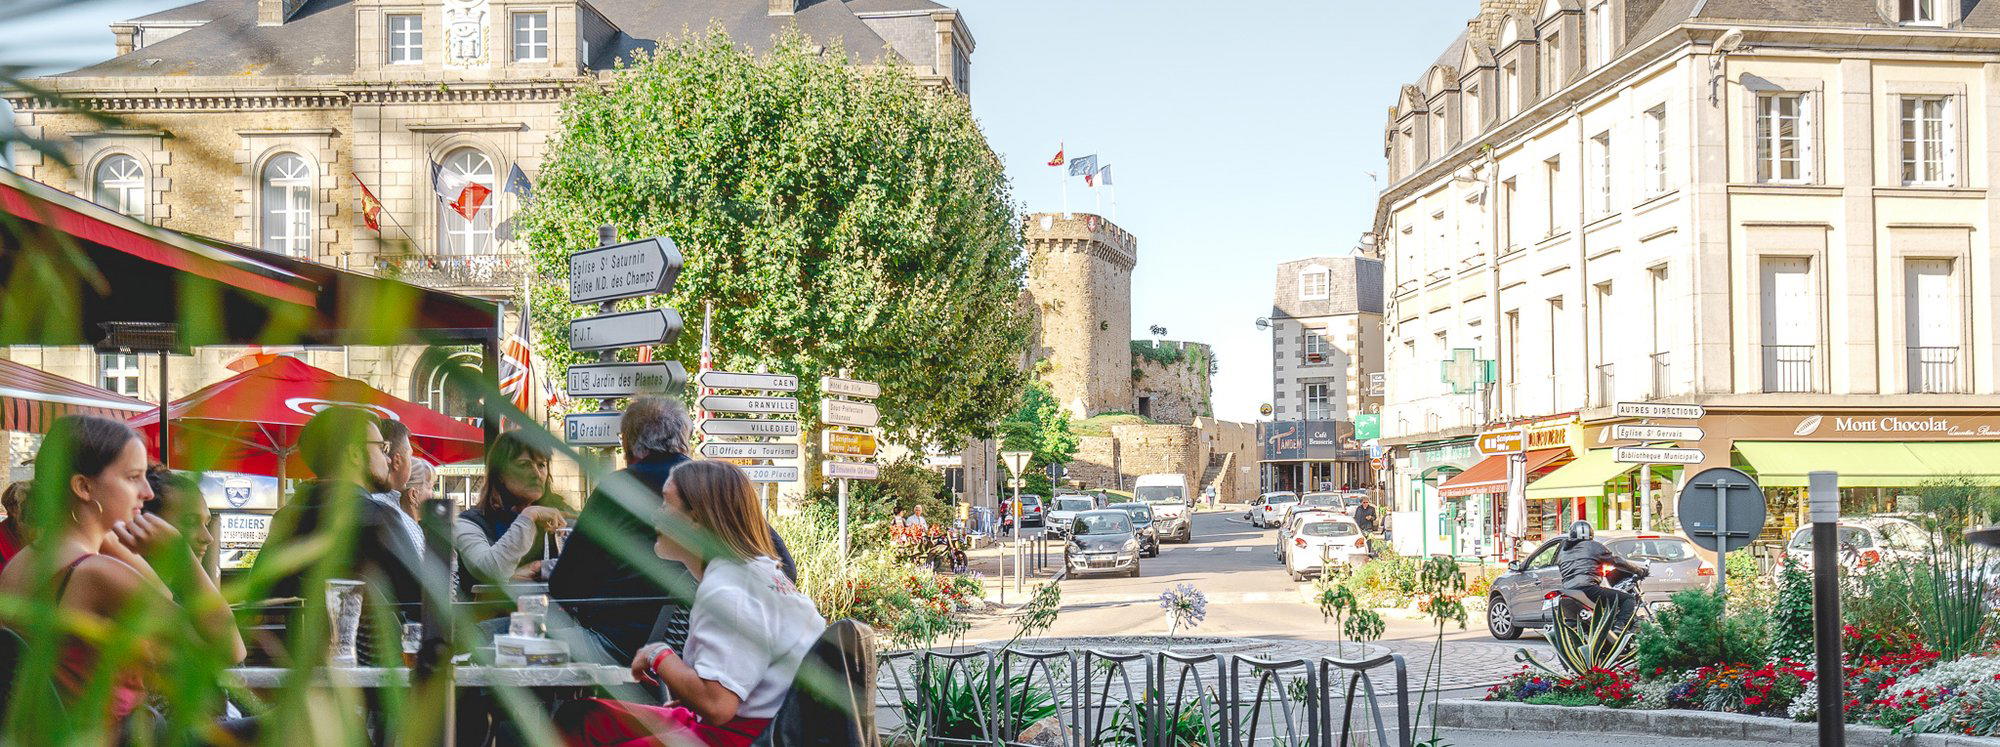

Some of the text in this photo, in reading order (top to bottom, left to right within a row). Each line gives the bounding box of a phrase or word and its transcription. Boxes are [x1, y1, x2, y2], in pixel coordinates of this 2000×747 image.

[611, 250, 645, 269] Saturnin
[611, 274, 623, 288] des
[626, 270, 654, 287] Champs
[573, 327, 593, 341] F.J.T.
[592, 373, 663, 388] Jardin des Plantes
[773, 379, 794, 387] CAEN
[748, 401, 795, 410] GRANVILLE
[1620, 406, 1698, 416] AUTRES DIRECTIONS
[751, 424, 795, 433] VILLEDIEU
[1835, 416, 1949, 432] Mont Chocolat
[580, 422, 611, 437] Gratuit
[1657, 429, 1683, 438] Gervais
[1314, 431, 1327, 439] Café
[1309, 438, 1333, 446] Brasserie
[719, 446, 795, 455] Office du Tourisme
[1664, 452, 1699, 461] Municipale
[753, 470, 769, 478] 200
[771, 470, 795, 478] Places
[227, 515, 265, 530] BÉZIERS
